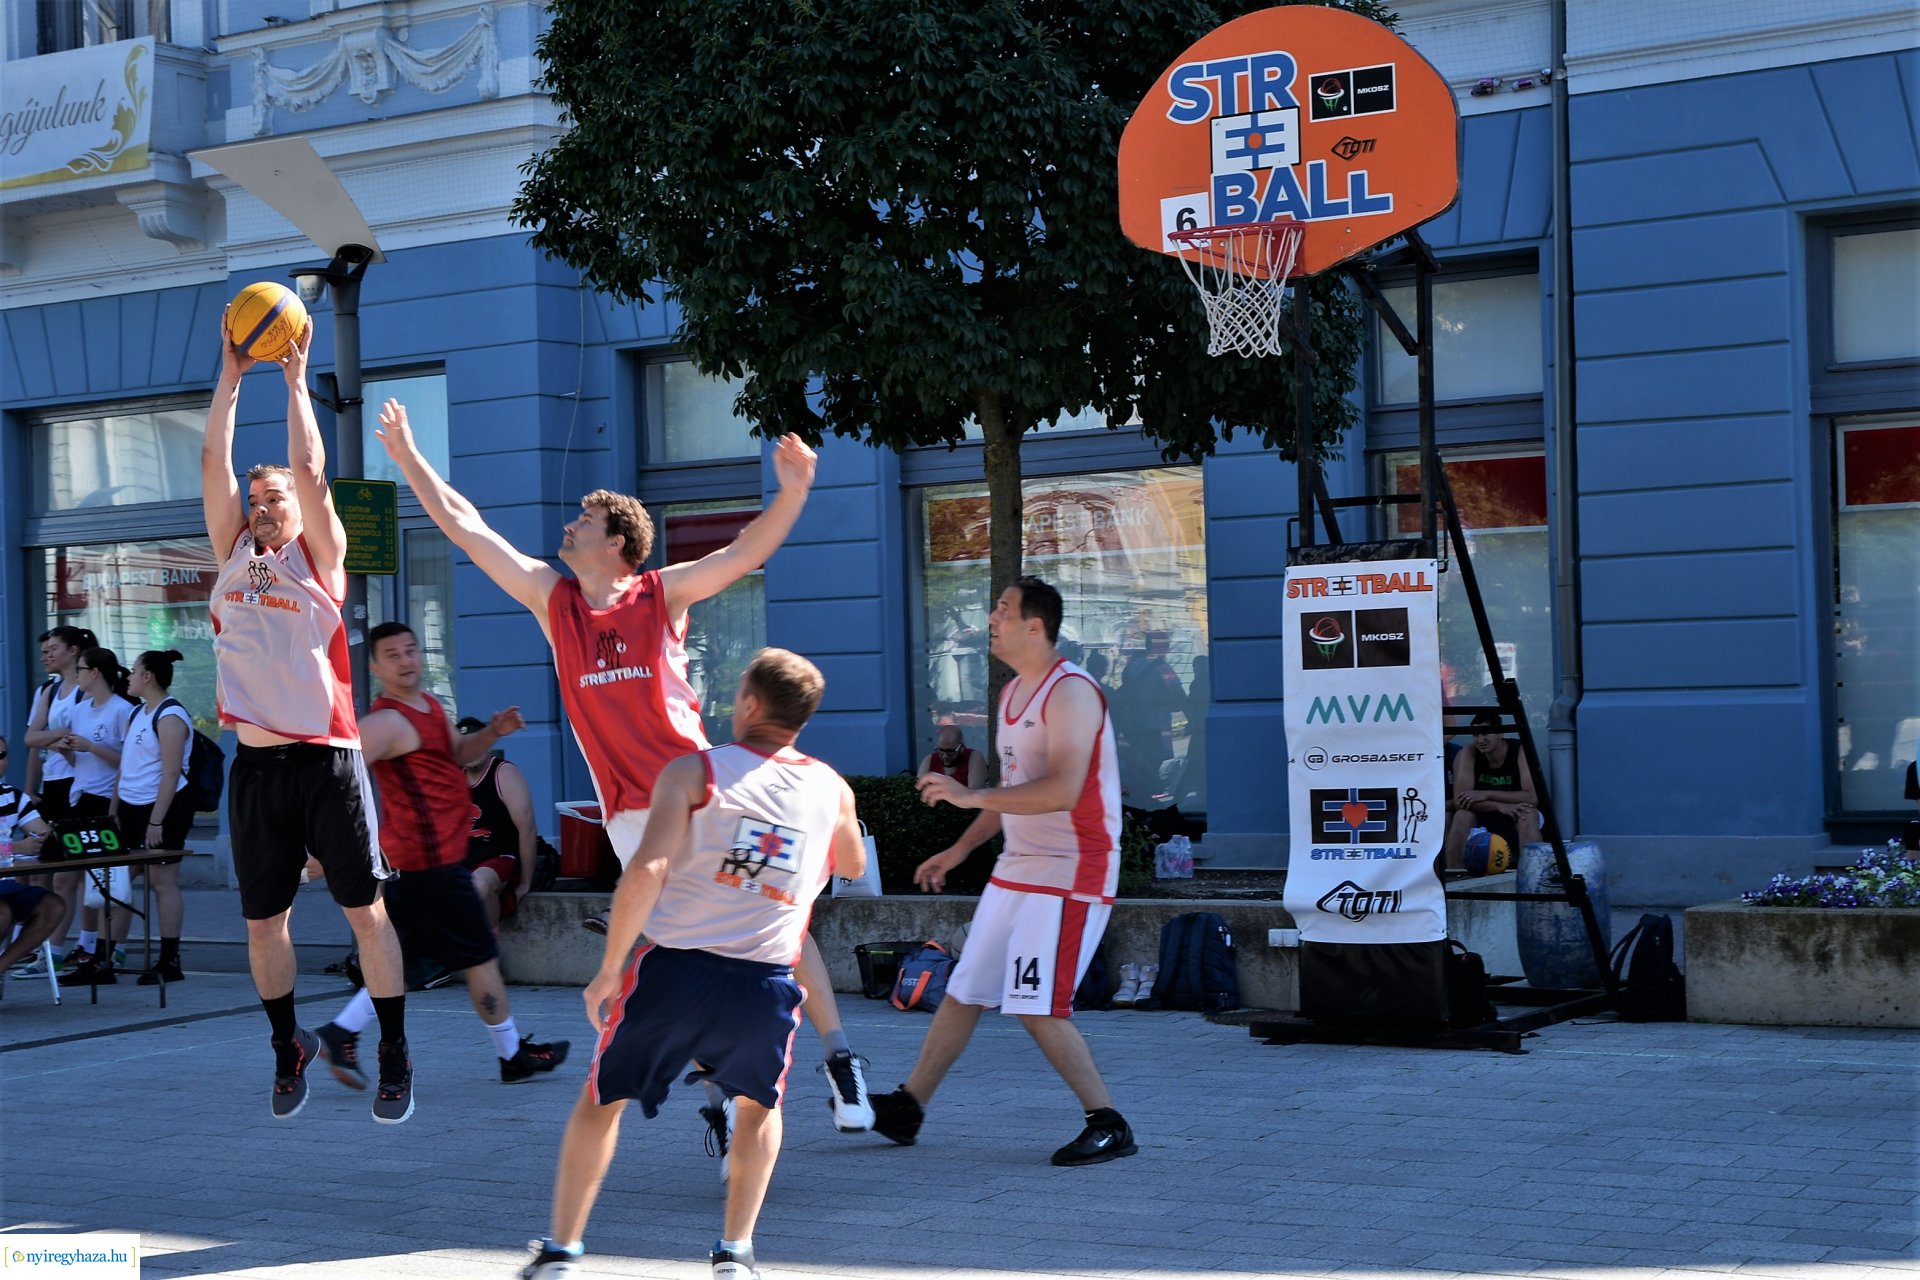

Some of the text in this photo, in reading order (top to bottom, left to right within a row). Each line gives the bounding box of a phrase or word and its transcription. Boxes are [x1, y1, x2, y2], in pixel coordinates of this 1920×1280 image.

[1166, 51, 1300, 124] STR
[1357, 85, 1389, 94] MKOSZ
[1211, 159, 1393, 227] BALL
[1176, 207, 1198, 229] 6
[160, 567, 201, 586] BANK
[1287, 572, 1433, 599] STREETBALL
[1361, 632, 1405, 642] MKOSZ
[1306, 693, 1414, 724] MVM
[1307, 753, 1425, 763] GB GROSBASKET
[62, 829, 120, 854] 9 55 9
[1310, 847, 1417, 861] STREETBALL
[1336, 889, 1403, 915] TOTI
[1014, 956, 1041, 991] 14
